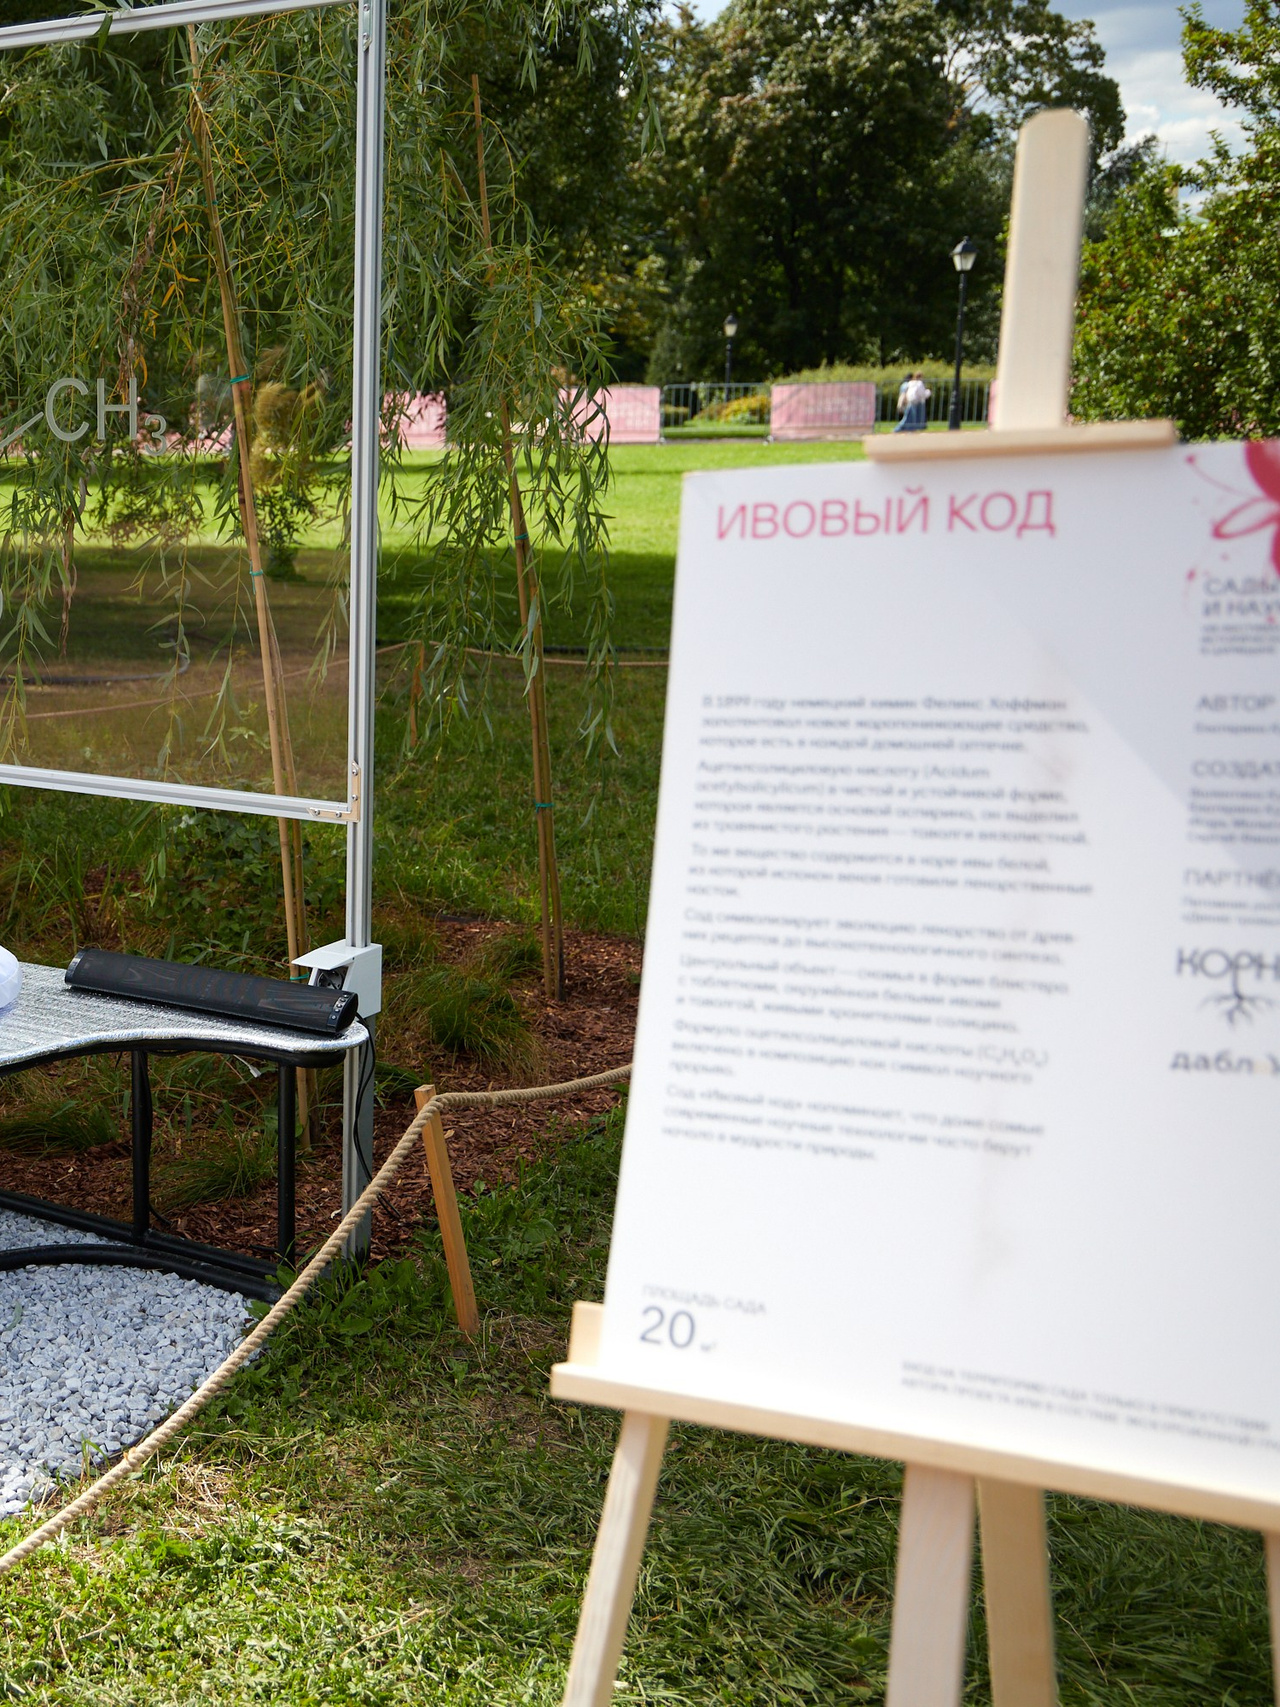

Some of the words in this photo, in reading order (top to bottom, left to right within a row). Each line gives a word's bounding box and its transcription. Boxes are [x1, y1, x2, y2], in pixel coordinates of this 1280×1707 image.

[717, 487, 930, 540] ИВОВЫЙ
[946, 488, 1058, 539] КОД
[1196, 695, 1276, 712] АВТОР
[1170, 1050, 1254, 1075] дабл
[640, 1305, 696, 1349] 20
